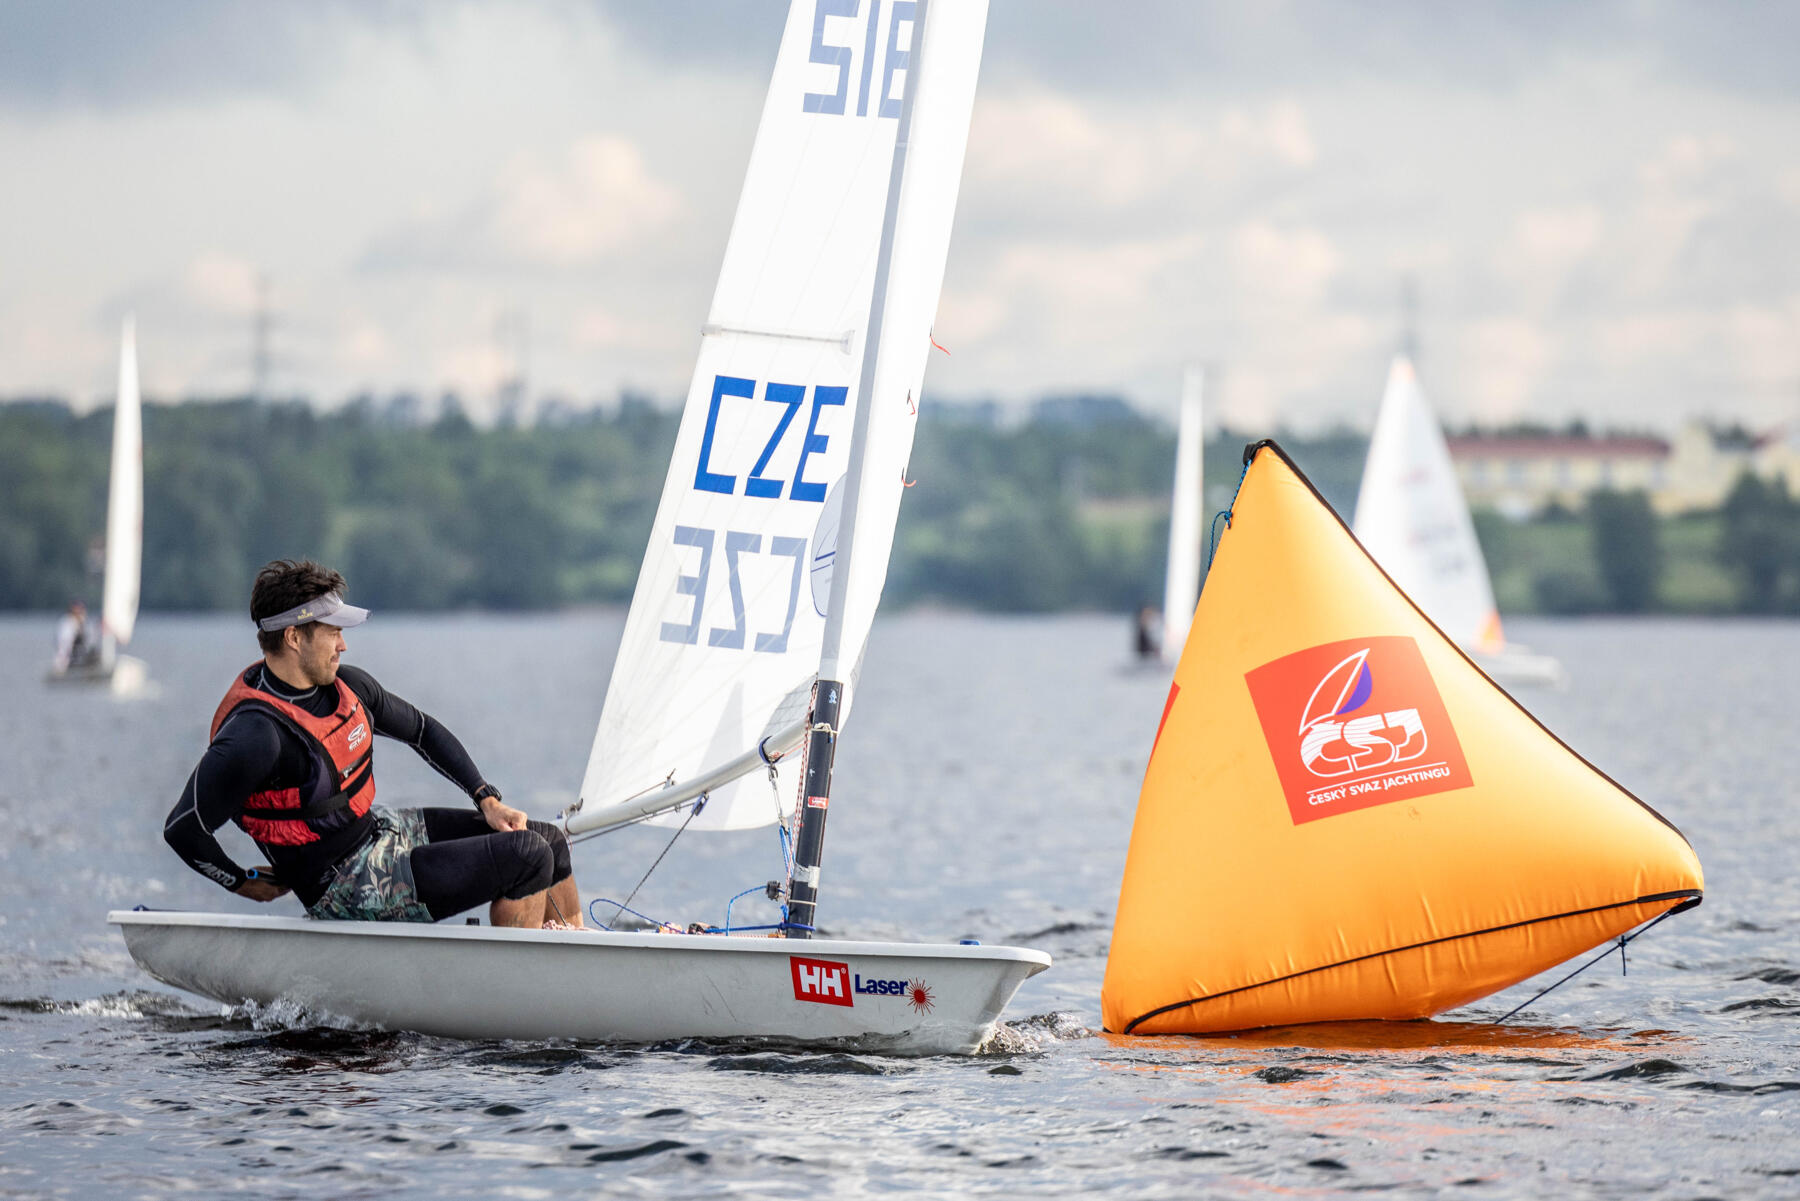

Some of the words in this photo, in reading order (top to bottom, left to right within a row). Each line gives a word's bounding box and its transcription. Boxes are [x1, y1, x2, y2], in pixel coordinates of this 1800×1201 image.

[693, 374, 849, 503] CZE
[1308, 786, 1347, 805] ČESKÝ
[1350, 780, 1382, 796] SVAZ
[1383, 766, 1451, 791] JACHTINGU
[854, 973, 909, 995] Laser
